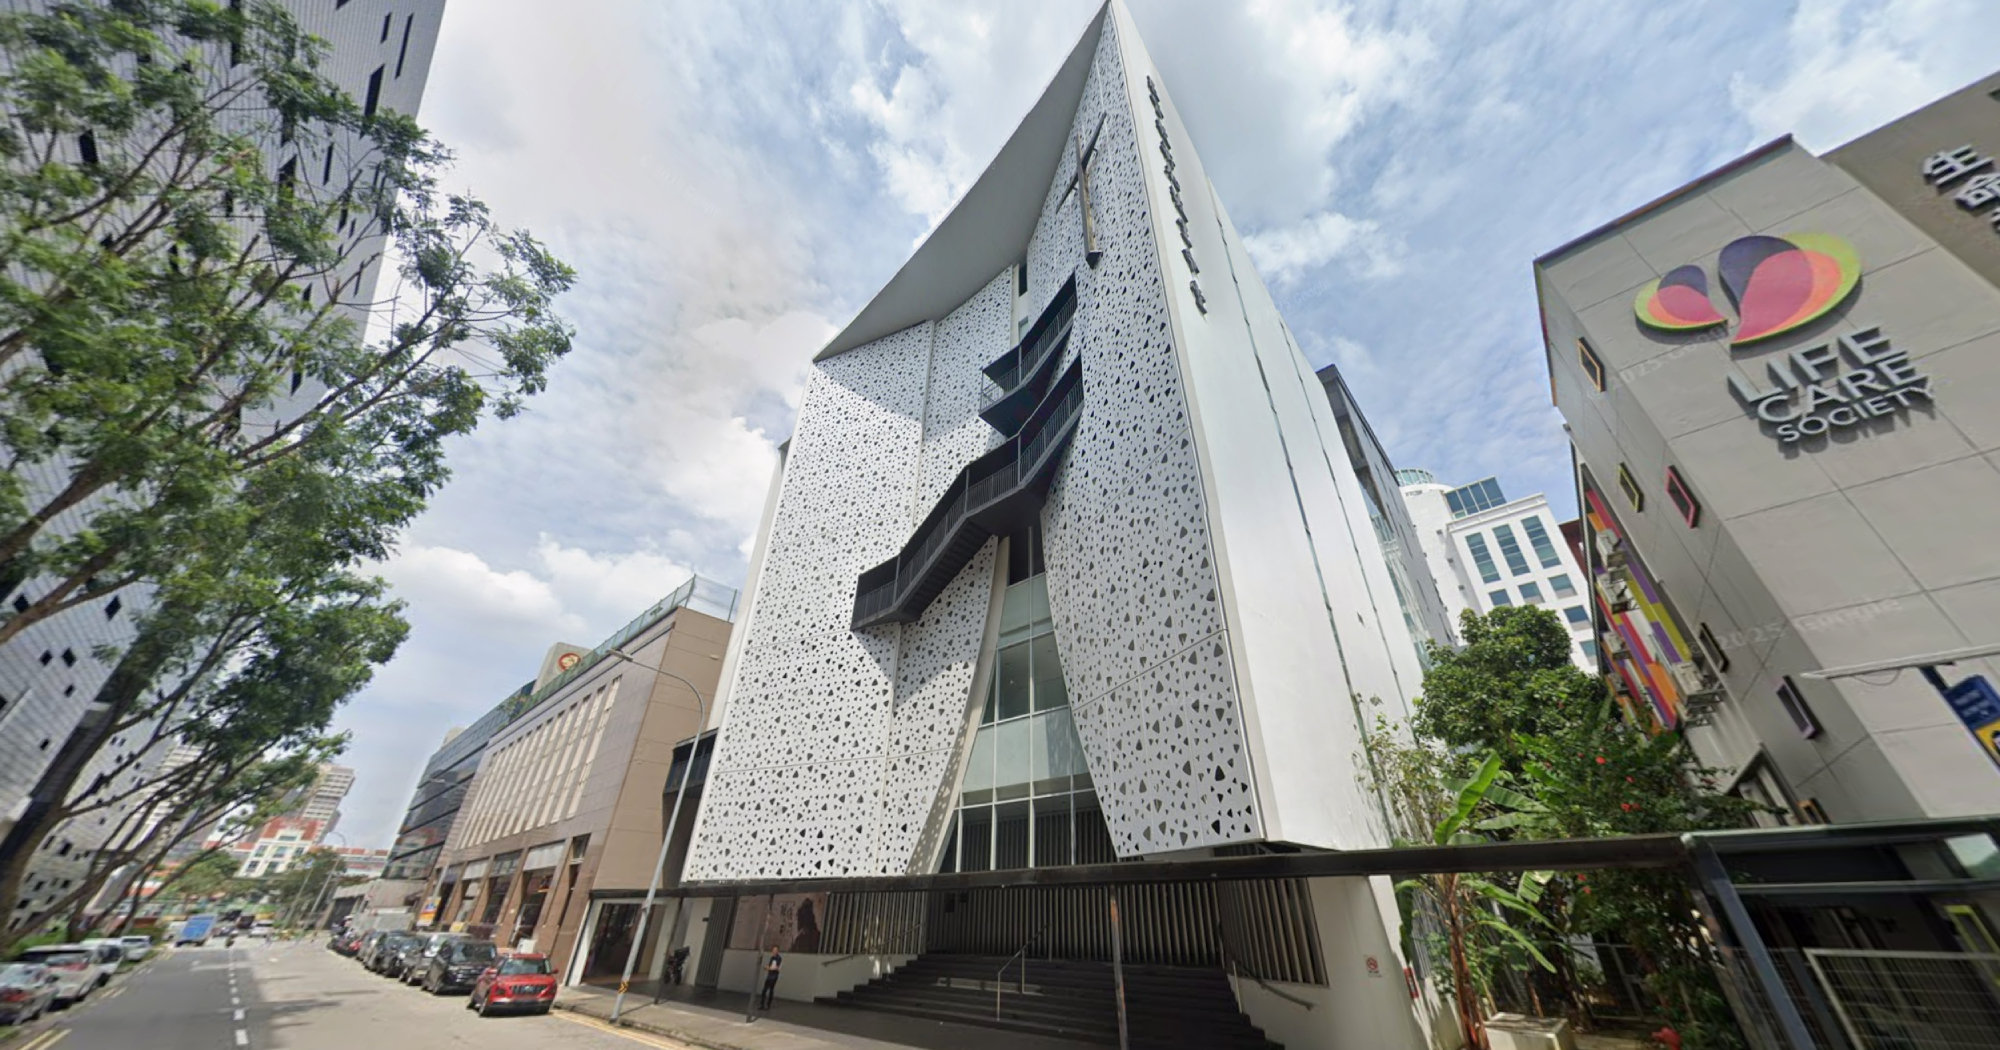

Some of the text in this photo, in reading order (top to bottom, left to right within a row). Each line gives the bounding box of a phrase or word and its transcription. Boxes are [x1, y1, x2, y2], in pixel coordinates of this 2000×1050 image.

[1726, 325, 1909, 403] LIFE
[1757, 351, 1929, 423] CARE
[1776, 378, 1935, 442] SOCIETY
